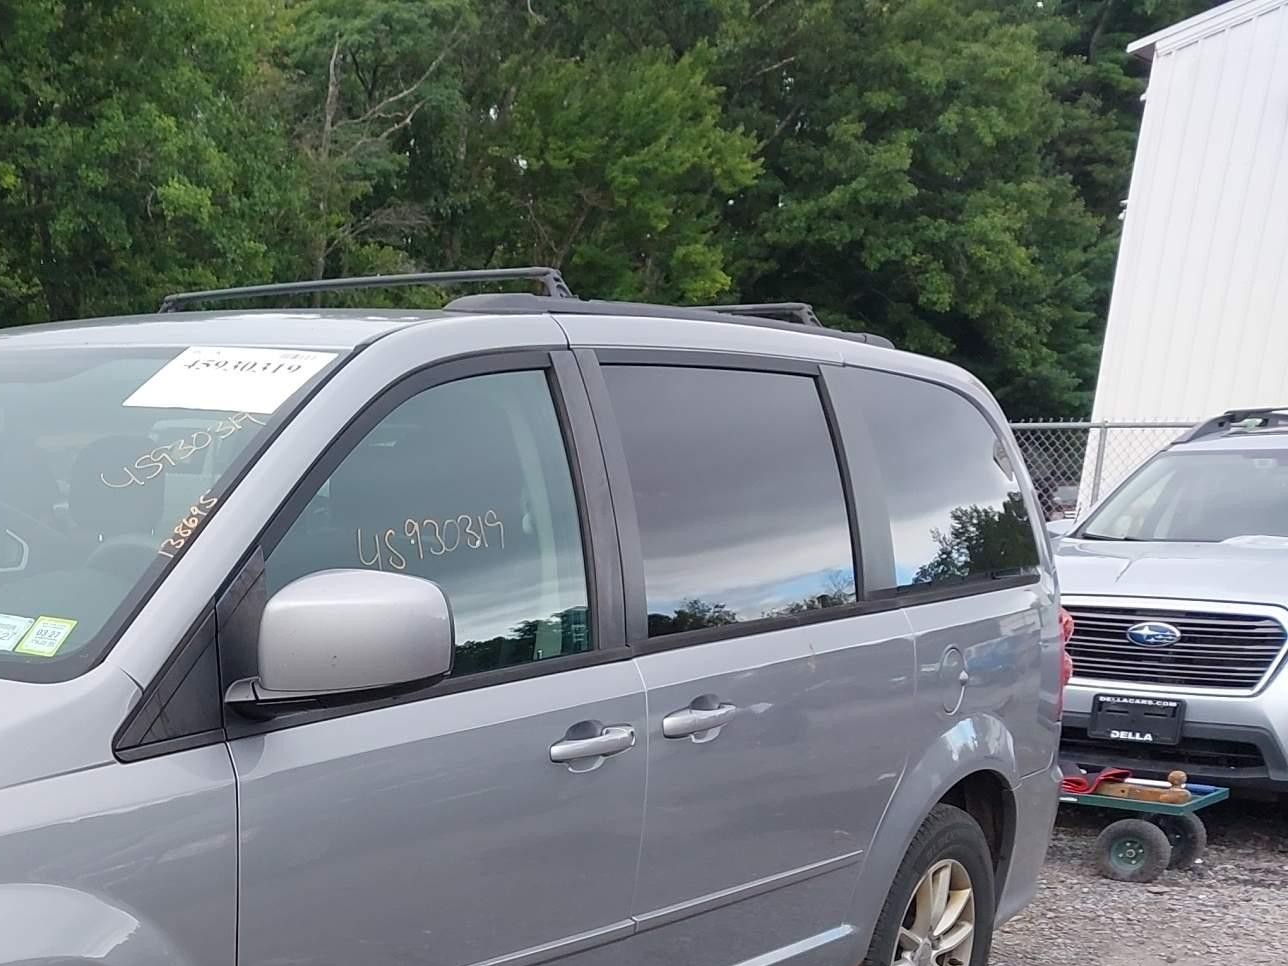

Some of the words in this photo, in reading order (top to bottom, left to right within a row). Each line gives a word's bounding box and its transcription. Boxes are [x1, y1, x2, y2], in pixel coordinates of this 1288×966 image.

[356, 509, 505, 571] 45930319
[1099, 696, 1177, 707] DELLACARS.COM
[1111, 730, 1153, 741] DELLA
